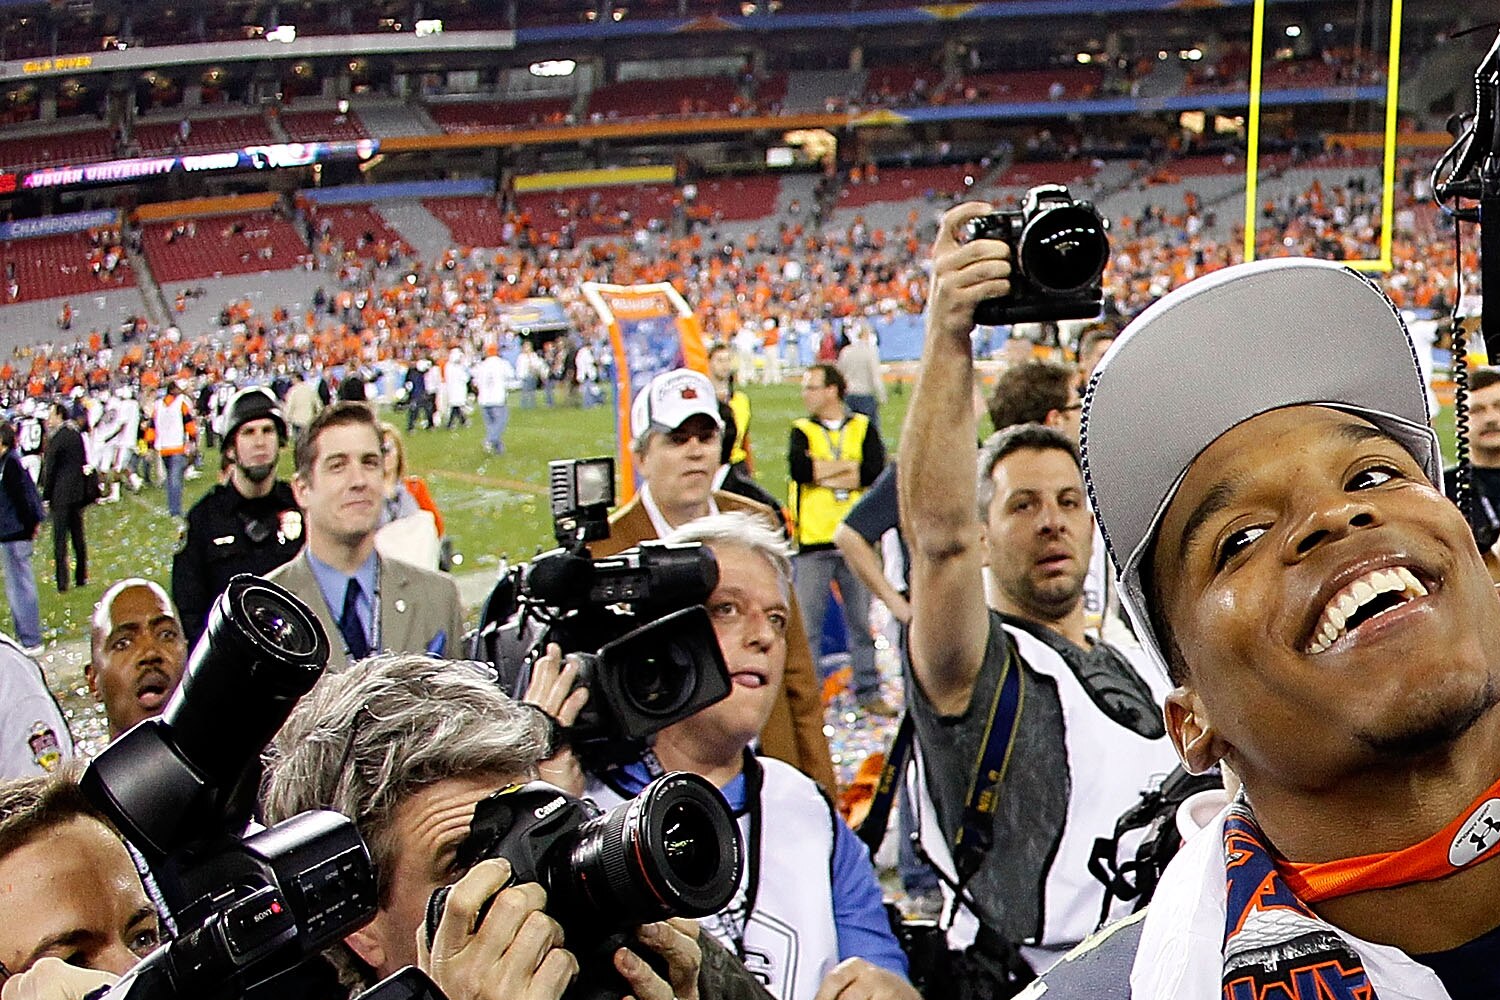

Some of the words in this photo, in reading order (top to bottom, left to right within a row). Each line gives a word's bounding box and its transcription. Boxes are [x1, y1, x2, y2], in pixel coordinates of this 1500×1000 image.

[23, 168, 84, 189] AUBURN
[84, 158, 175, 180] UNIVERSITY
[533, 796, 567, 820] Canon
[253, 907, 274, 924] SONY
